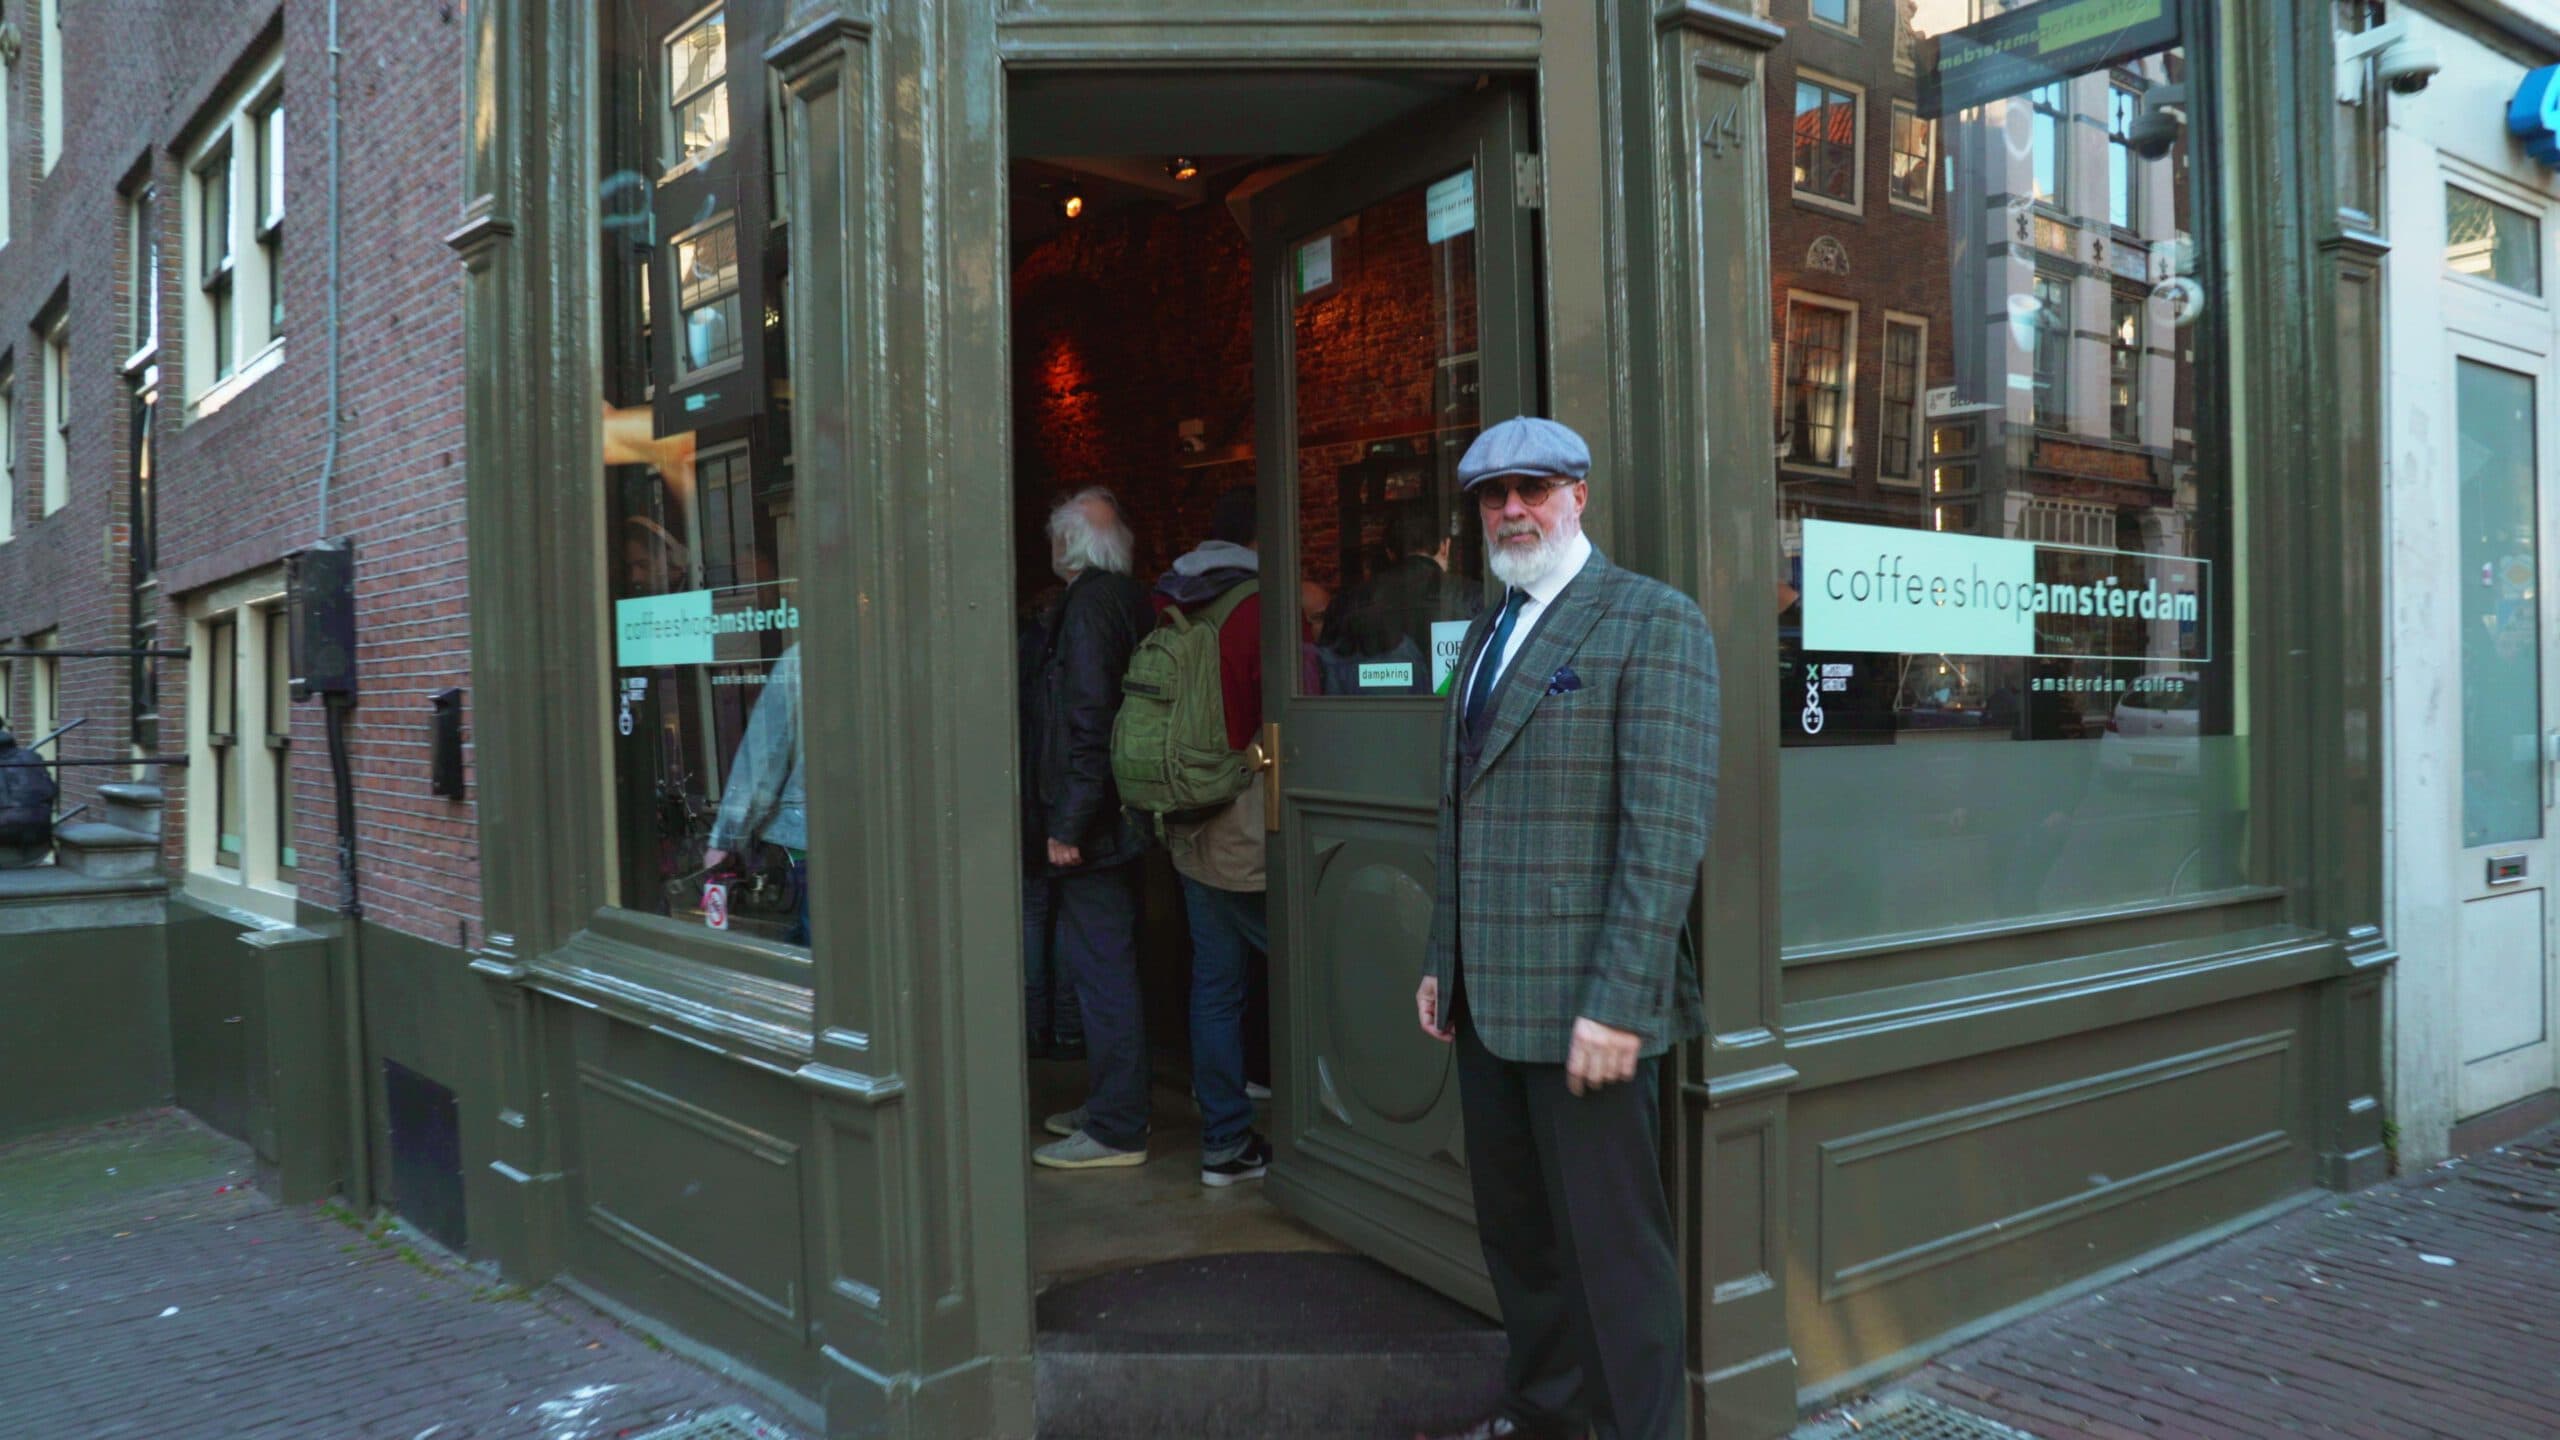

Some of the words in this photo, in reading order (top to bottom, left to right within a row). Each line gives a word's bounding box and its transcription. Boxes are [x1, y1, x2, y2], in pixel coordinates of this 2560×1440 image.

[1702, 103, 1742, 159] 44
[1362, 669, 1409, 682] dampkring
[2031, 675, 2126, 692] amsterdam
[2133, 675, 2184, 692] coffee
